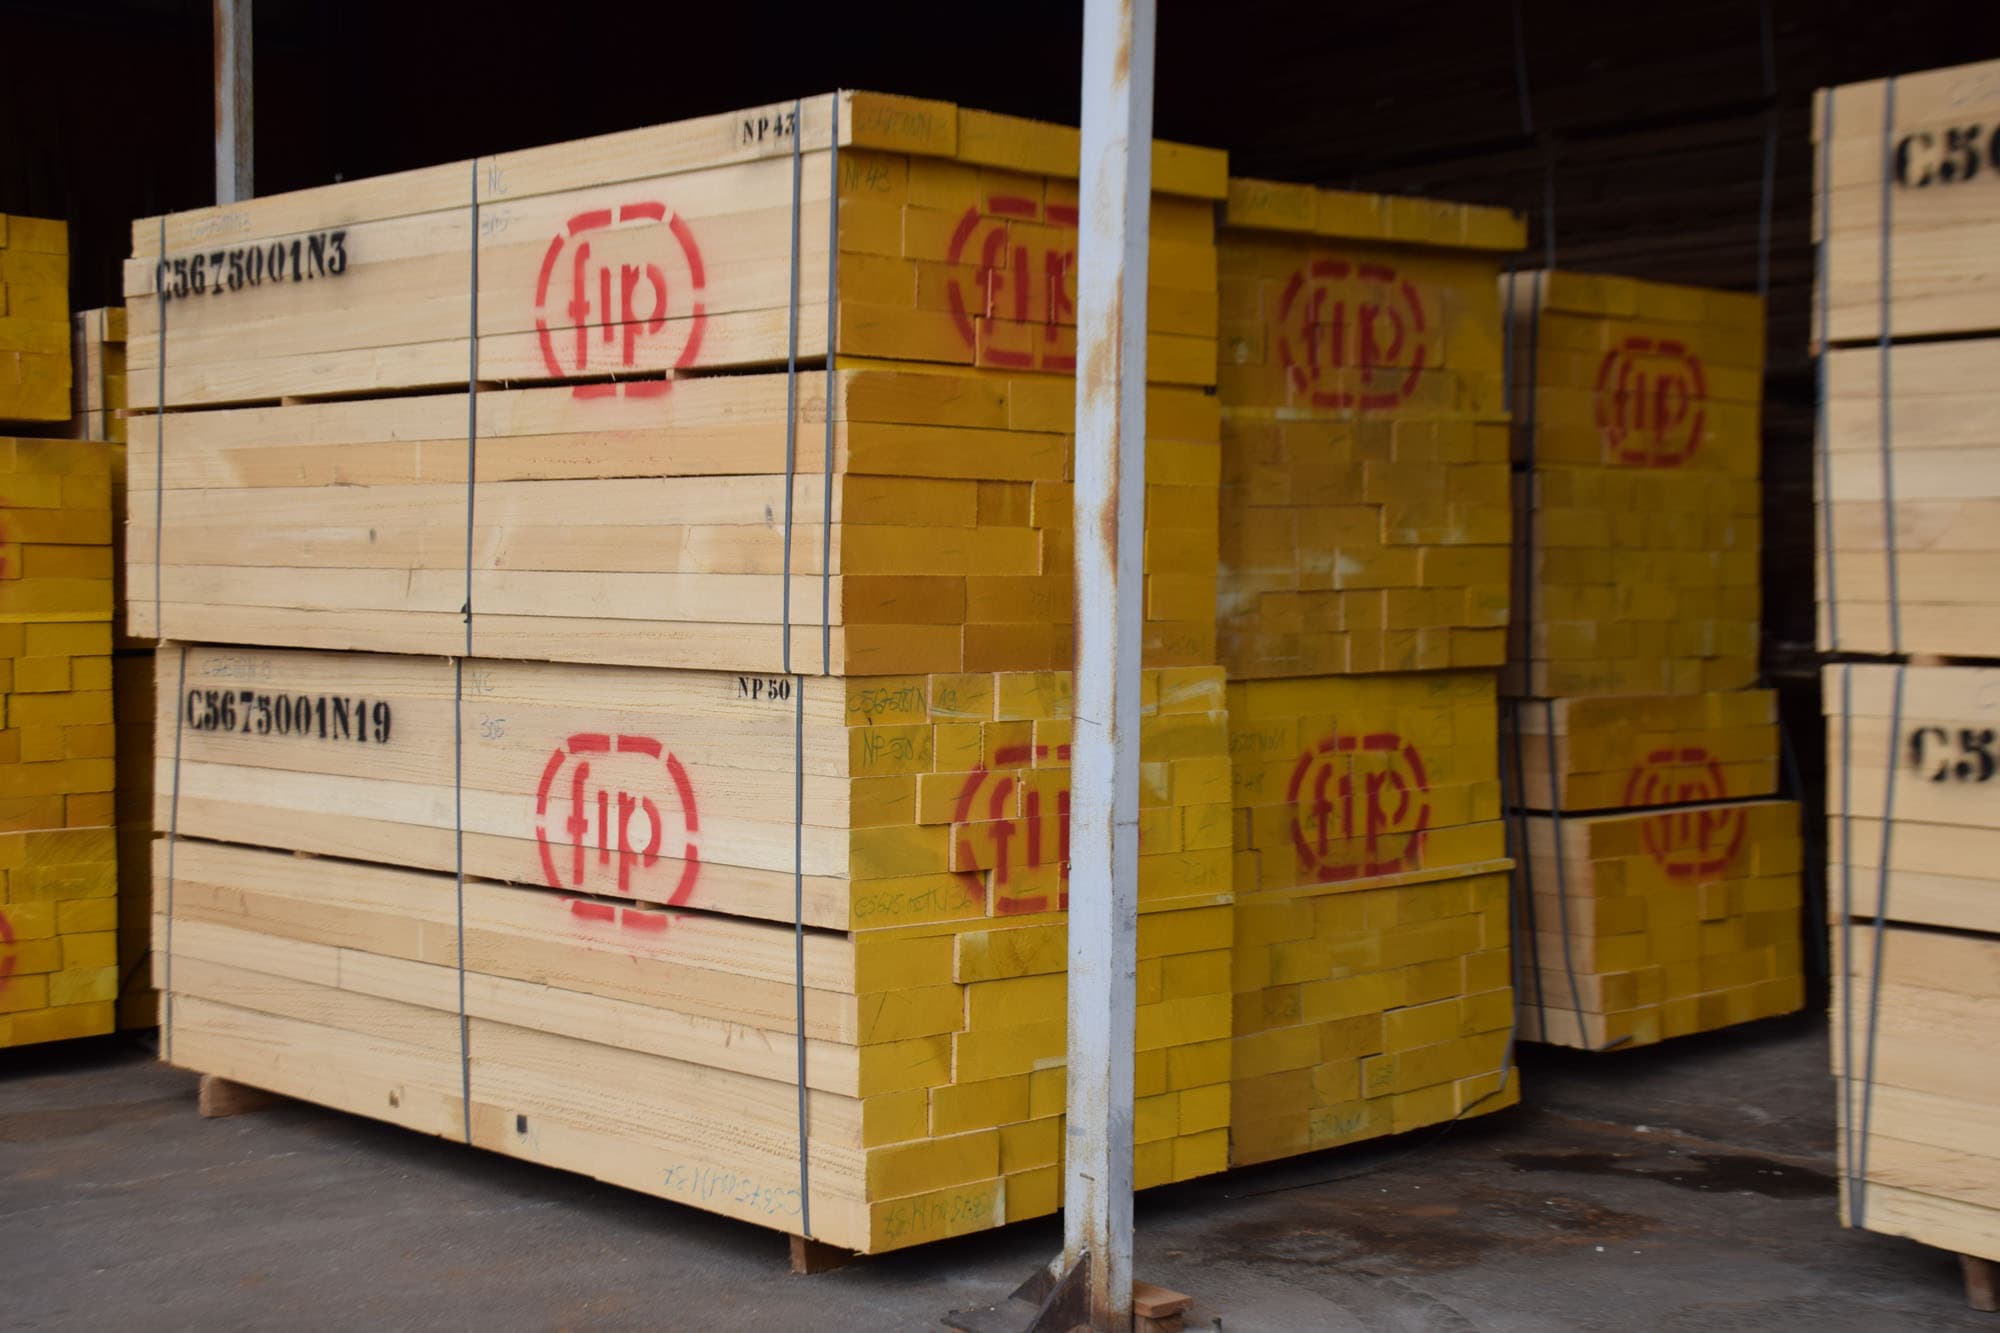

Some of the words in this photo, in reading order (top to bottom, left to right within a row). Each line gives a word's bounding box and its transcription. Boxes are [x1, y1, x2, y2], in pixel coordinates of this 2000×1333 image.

[1895, 124, 2000, 188] C5
[155, 230, 348, 302] C5675001N3
[187, 690, 393, 744] C5675001N19
